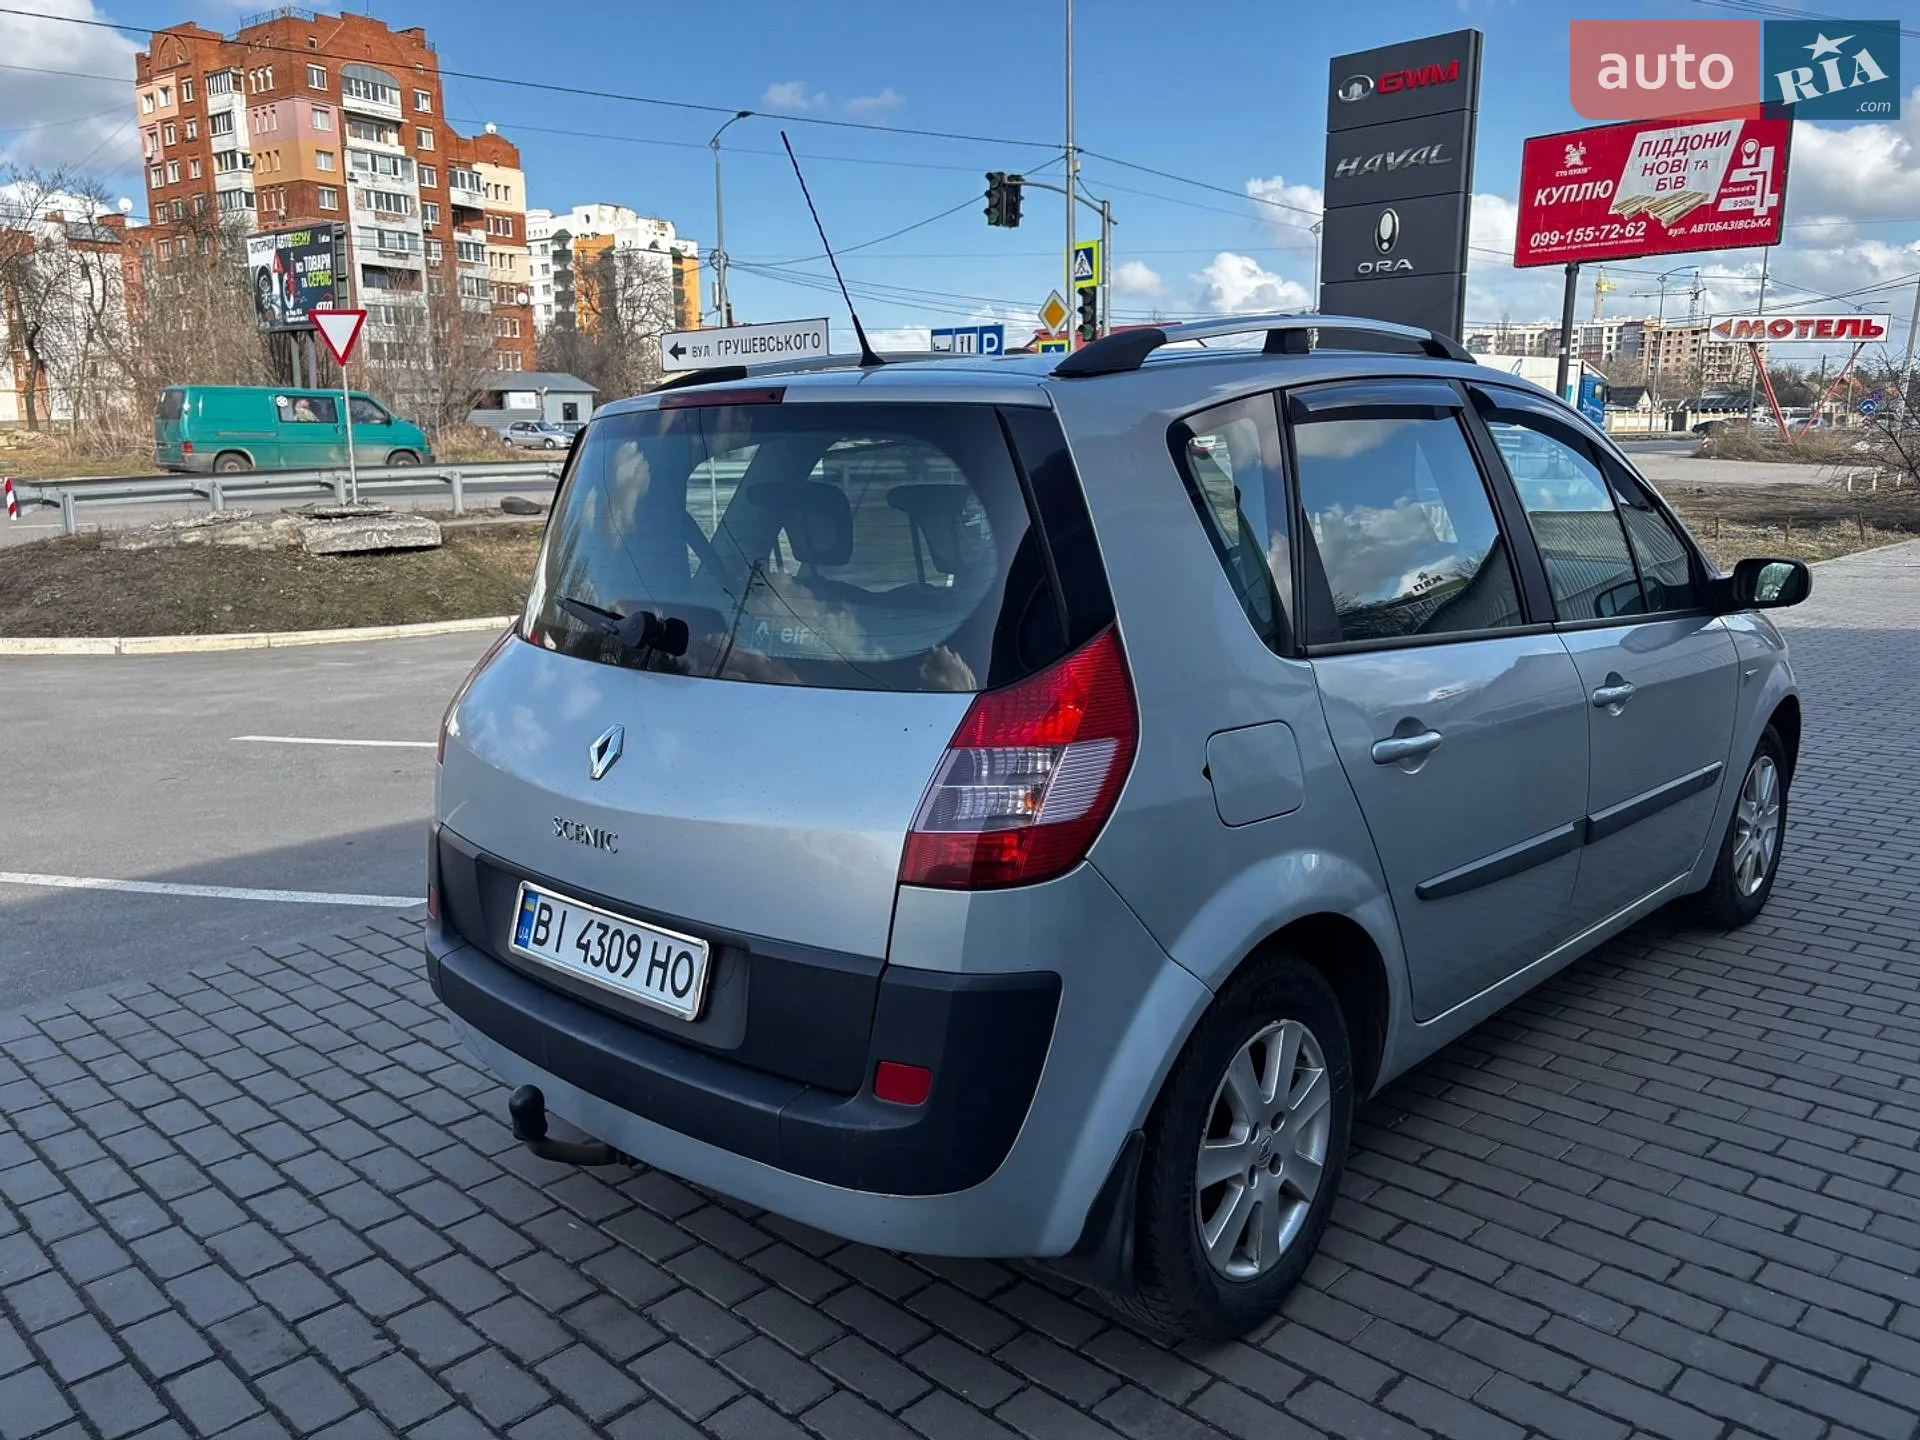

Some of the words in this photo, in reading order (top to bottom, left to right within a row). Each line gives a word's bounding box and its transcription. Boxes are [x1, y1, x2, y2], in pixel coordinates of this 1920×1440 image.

[1378, 60, 1459, 95] GWM
[1638, 130, 1732, 160] ПІДДОНИ
[1334, 144, 1452, 179] HAVAL
[1641, 158, 1689, 177] НОВІ
[1693, 160, 1709, 172] ТА
[1533, 179, 1614, 207] КУПЛЮ
[1690, 217, 1772, 234] АВТОБАЗІВСЬКА
[1357, 258, 1414, 275] ORA
[1734, 319, 1884, 339] МОТЕЛЬ
[717, 332, 821, 356] ГРУШЕВСЬКОГО
[553, 815, 619, 854] SCENIC
[532, 902, 567, 953] BI
[575, 918, 642, 979] 4309
[645, 940, 695, 999] HO
